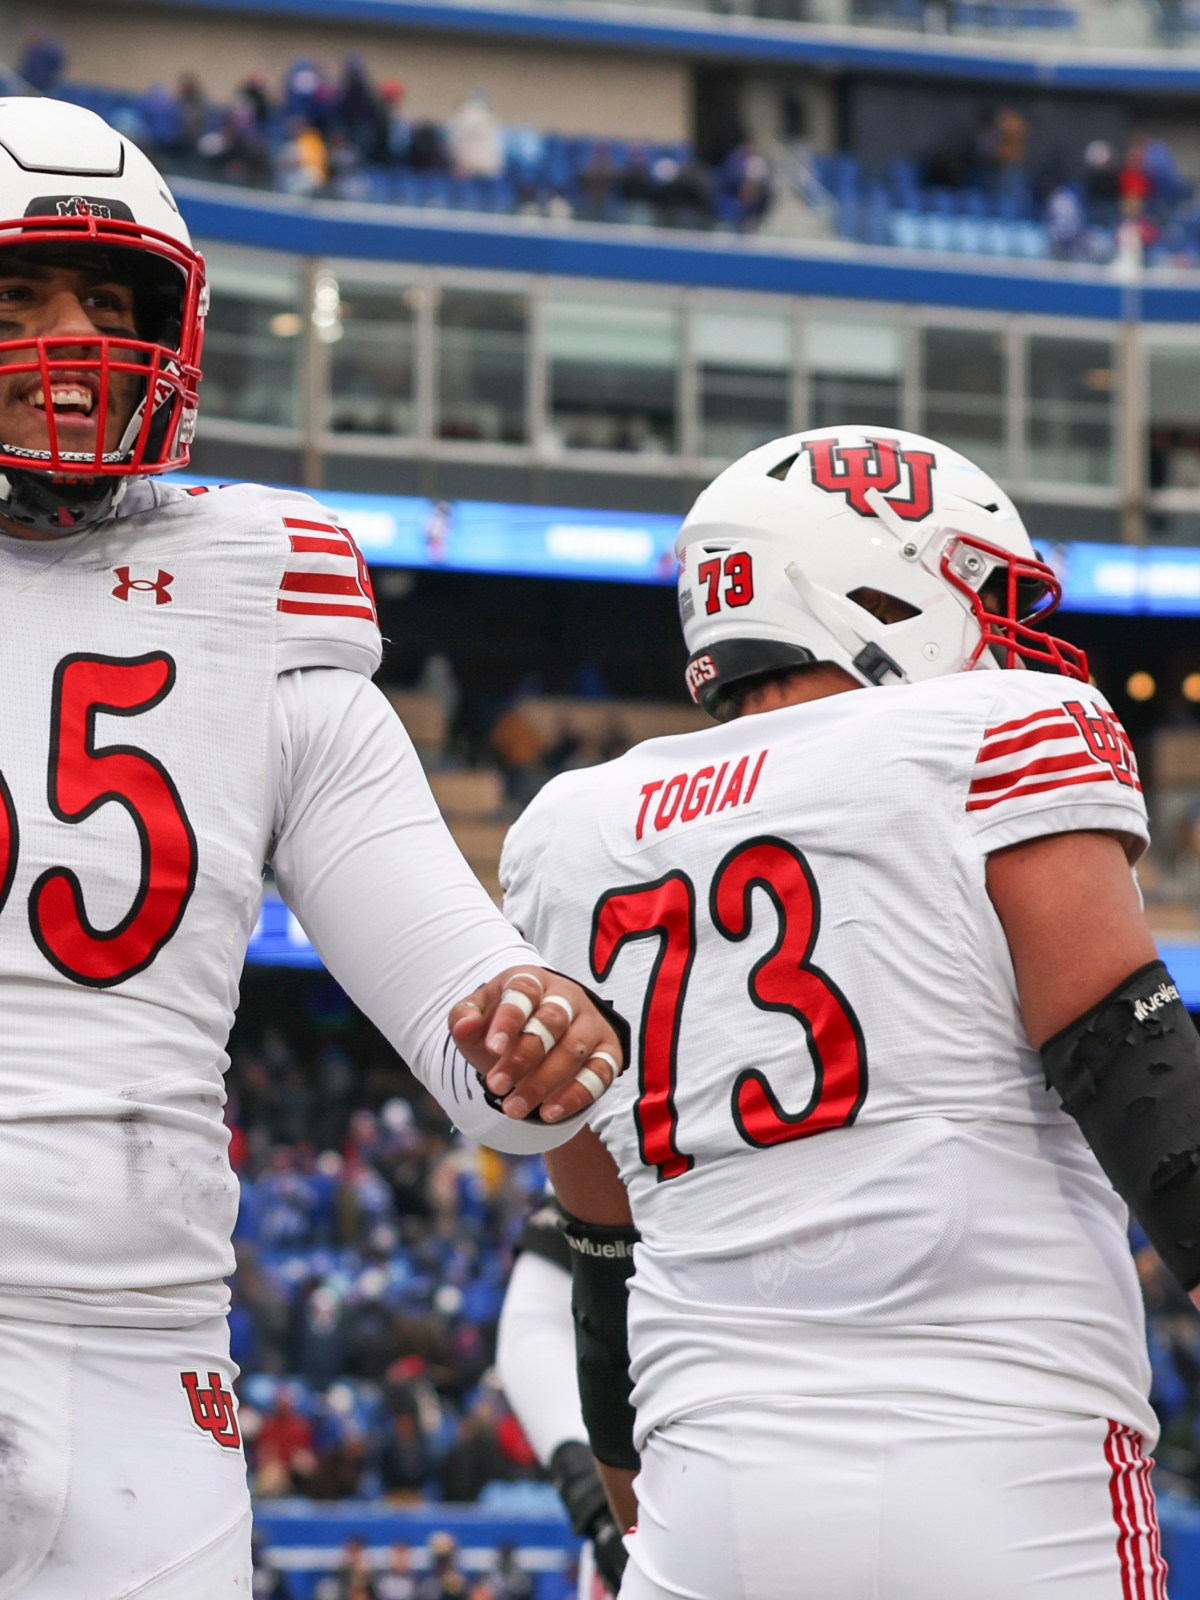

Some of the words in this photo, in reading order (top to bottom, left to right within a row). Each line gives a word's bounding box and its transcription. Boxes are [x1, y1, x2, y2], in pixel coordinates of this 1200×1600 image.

[698, 551, 754, 616] 73
[636, 749, 769, 841] TOGIAI
[589, 835, 868, 1183] 73
[576, 1238, 635, 1258] Muelle
